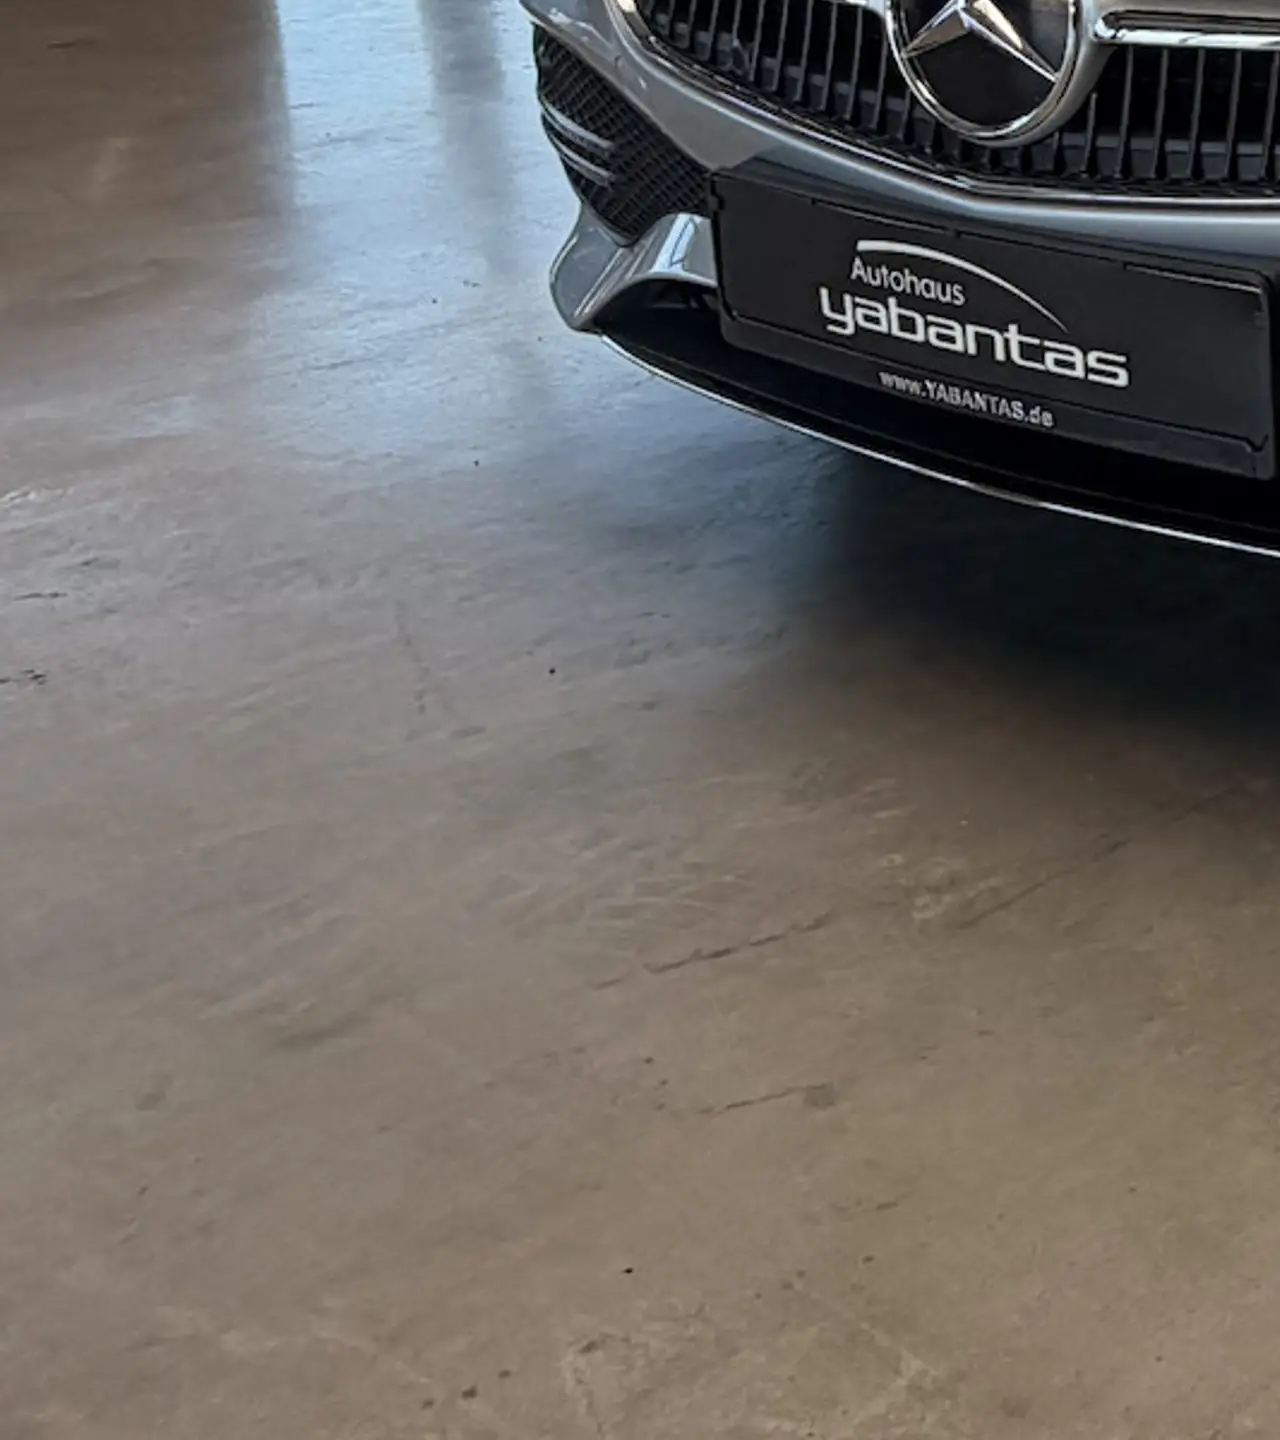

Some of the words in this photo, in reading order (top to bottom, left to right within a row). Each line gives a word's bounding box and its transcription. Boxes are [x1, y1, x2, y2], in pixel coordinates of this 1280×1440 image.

[850, 255, 966, 306] Autohaus
[818, 287, 1130, 388] yabantas
[878, 371, 1055, 428] www.YABANTAS.de
